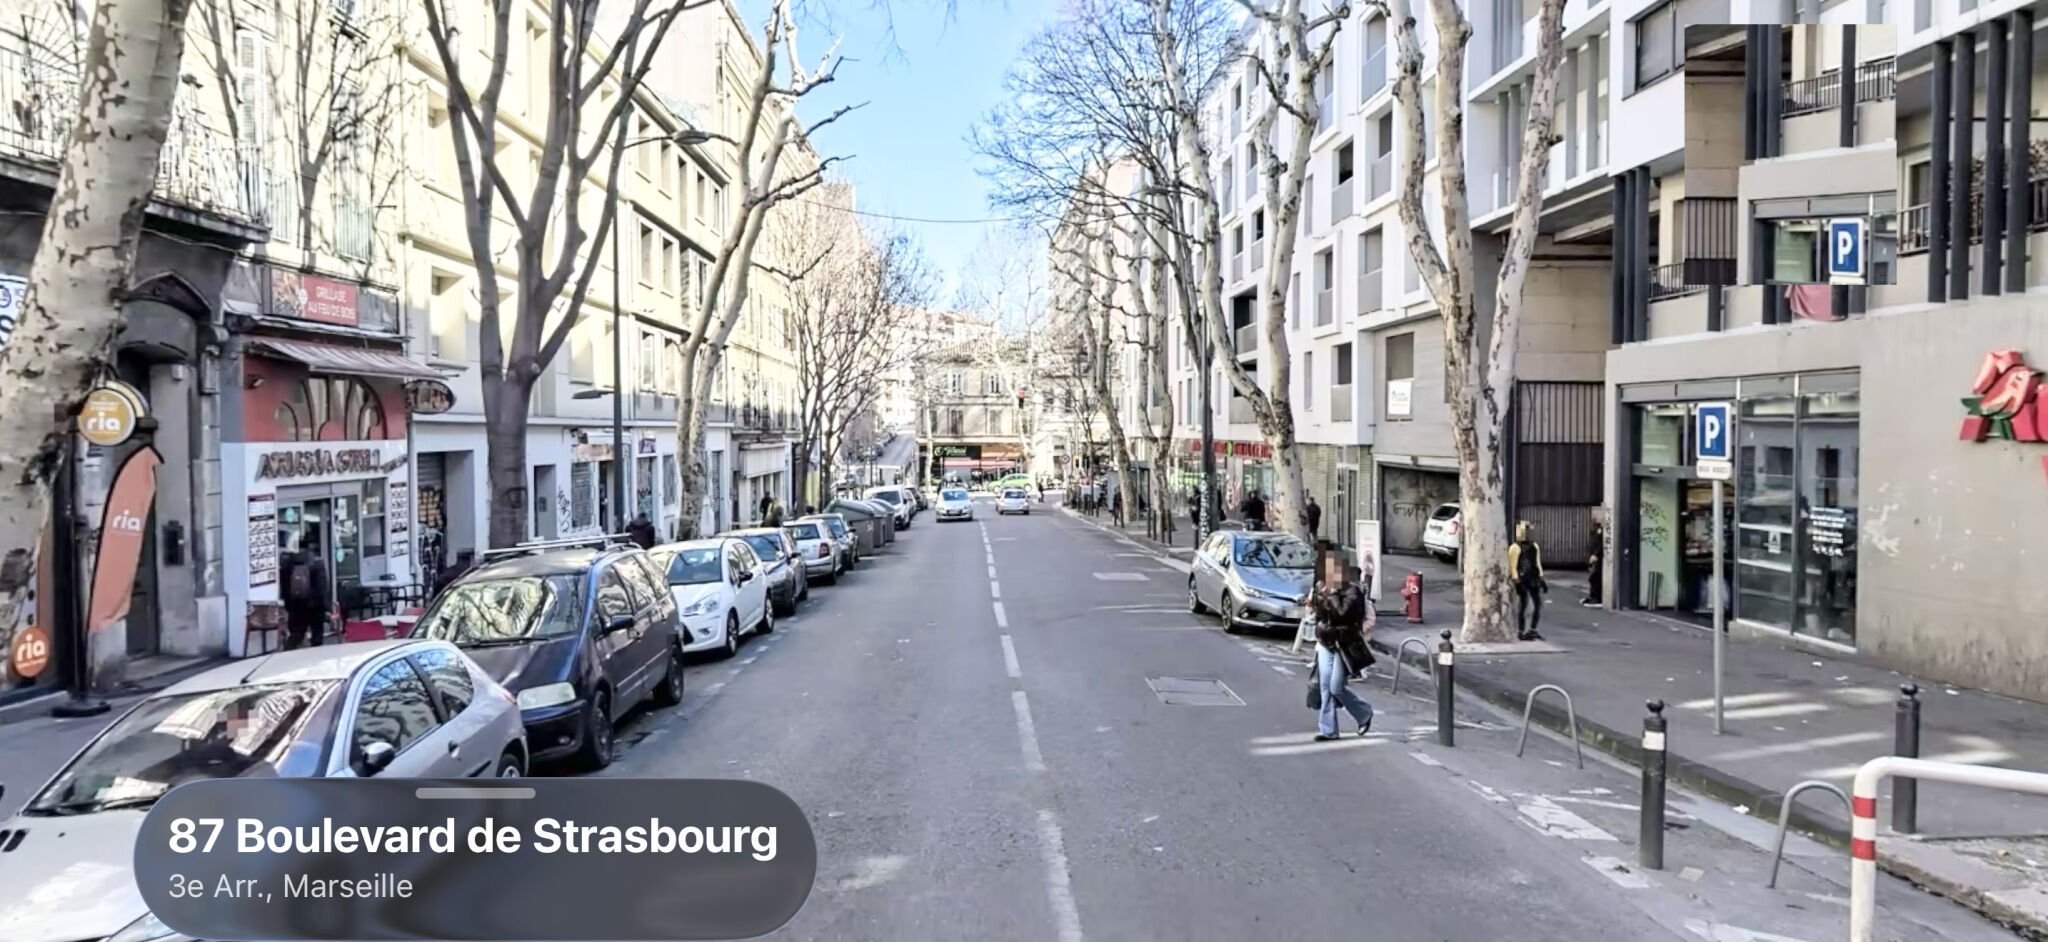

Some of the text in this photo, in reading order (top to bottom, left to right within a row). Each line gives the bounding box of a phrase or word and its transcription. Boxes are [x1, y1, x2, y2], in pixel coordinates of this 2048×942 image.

[1837, 230, 1854, 265] P
[316, 286, 347, 303] GRILLADE
[308, 301, 356, 320] AU FEU DE BOIS
[87, 411, 121, 431] ria
[1704, 414, 1721, 449] P
[112, 509, 141, 531] ria
[17, 634, 46, 662] ria
